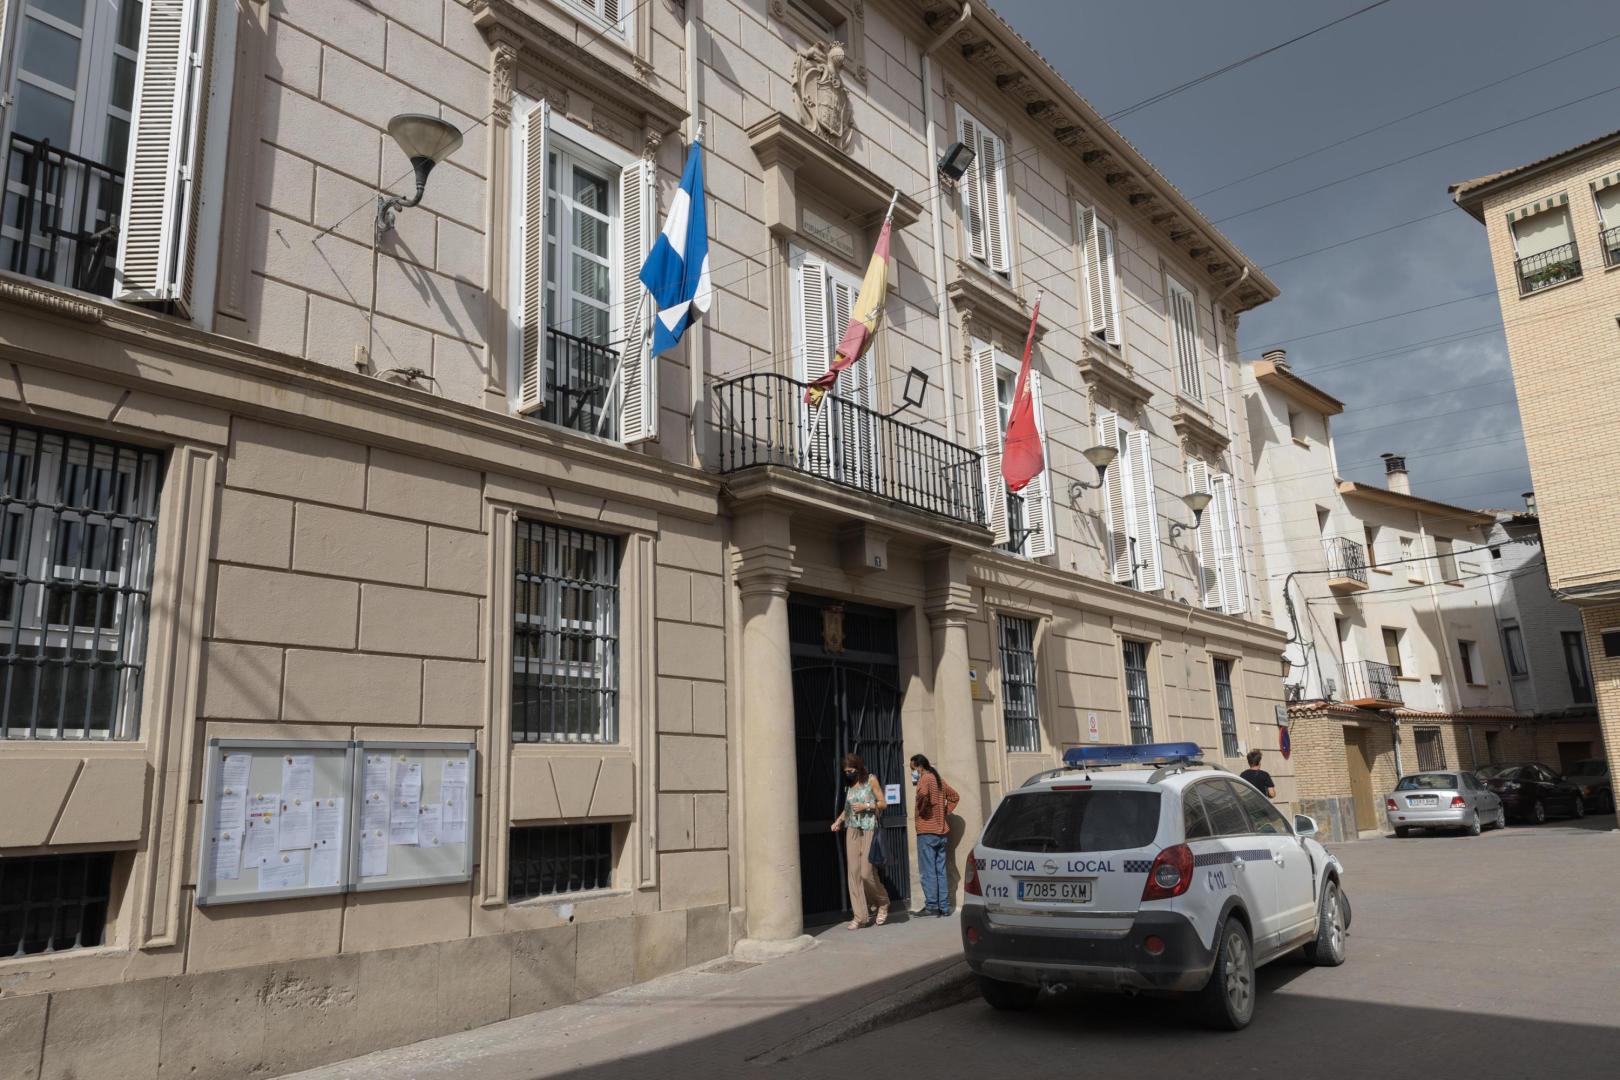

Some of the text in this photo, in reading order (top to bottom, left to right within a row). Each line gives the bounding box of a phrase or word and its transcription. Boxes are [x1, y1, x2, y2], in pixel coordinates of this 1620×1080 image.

[990, 859, 1116, 873] POLICIA LOCAL
[1213, 870, 1227, 889] 112
[991, 886, 1009, 898] 112
[1026, 883, 1087, 898] 7085 GXM
